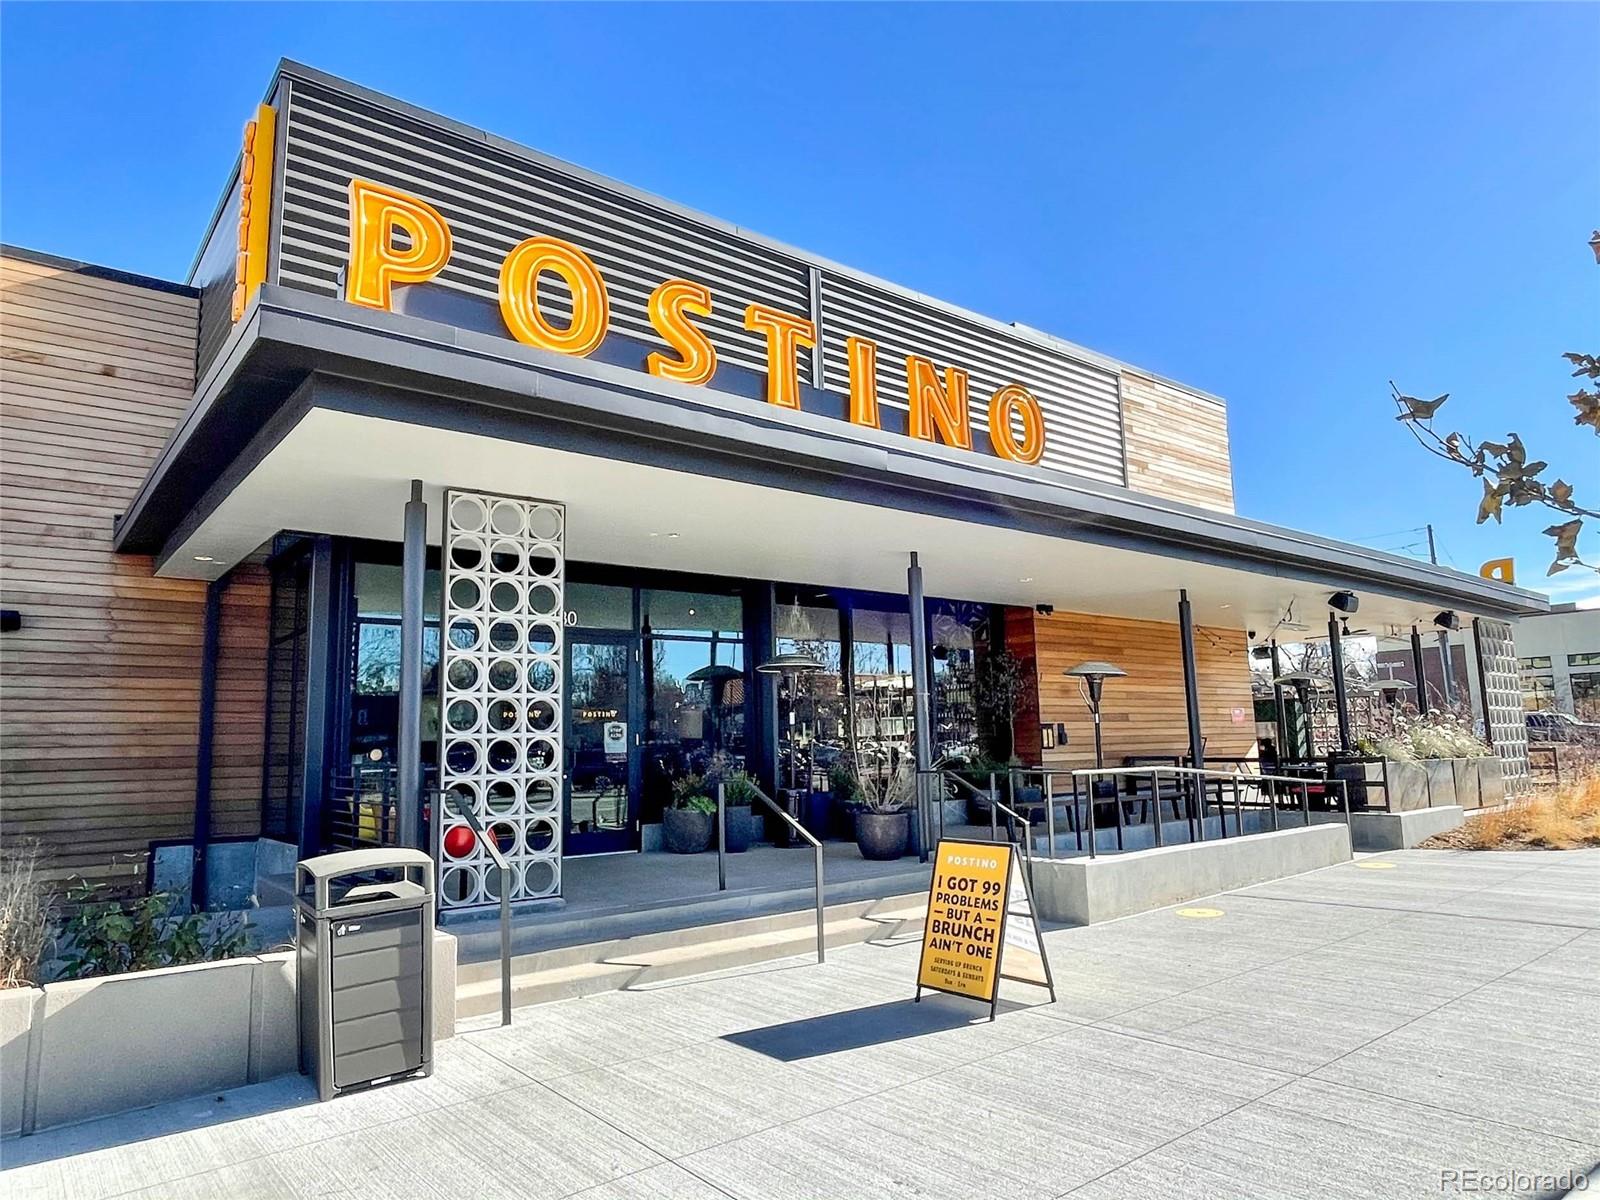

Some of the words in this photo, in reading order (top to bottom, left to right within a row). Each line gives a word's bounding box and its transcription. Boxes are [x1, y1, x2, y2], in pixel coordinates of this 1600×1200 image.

[346, 178, 1045, 465] POSTINO
[582, 710, 616, 718] POSTINO
[947, 855, 997, 869] POSTINO
[938, 875, 942, 888] I
[947, 876, 978, 892] GOT
[982, 880, 1001, 896] 99
[936, 892, 999, 911] PROBLEMS
[946, 908, 970, 921] BUT
[973, 912, 982, 924] A
[932, 919, 995, 943] BRUNCH
[929, 937, 963, 953] AIN'T
[966, 944, 992, 959] ONE
[930, 965, 956, 976] SATURDAYS
[962, 972, 984, 982] SUNDAYS
[934, 957, 953, 966] SERVING
[963, 962, 982, 972] BRUNCH
